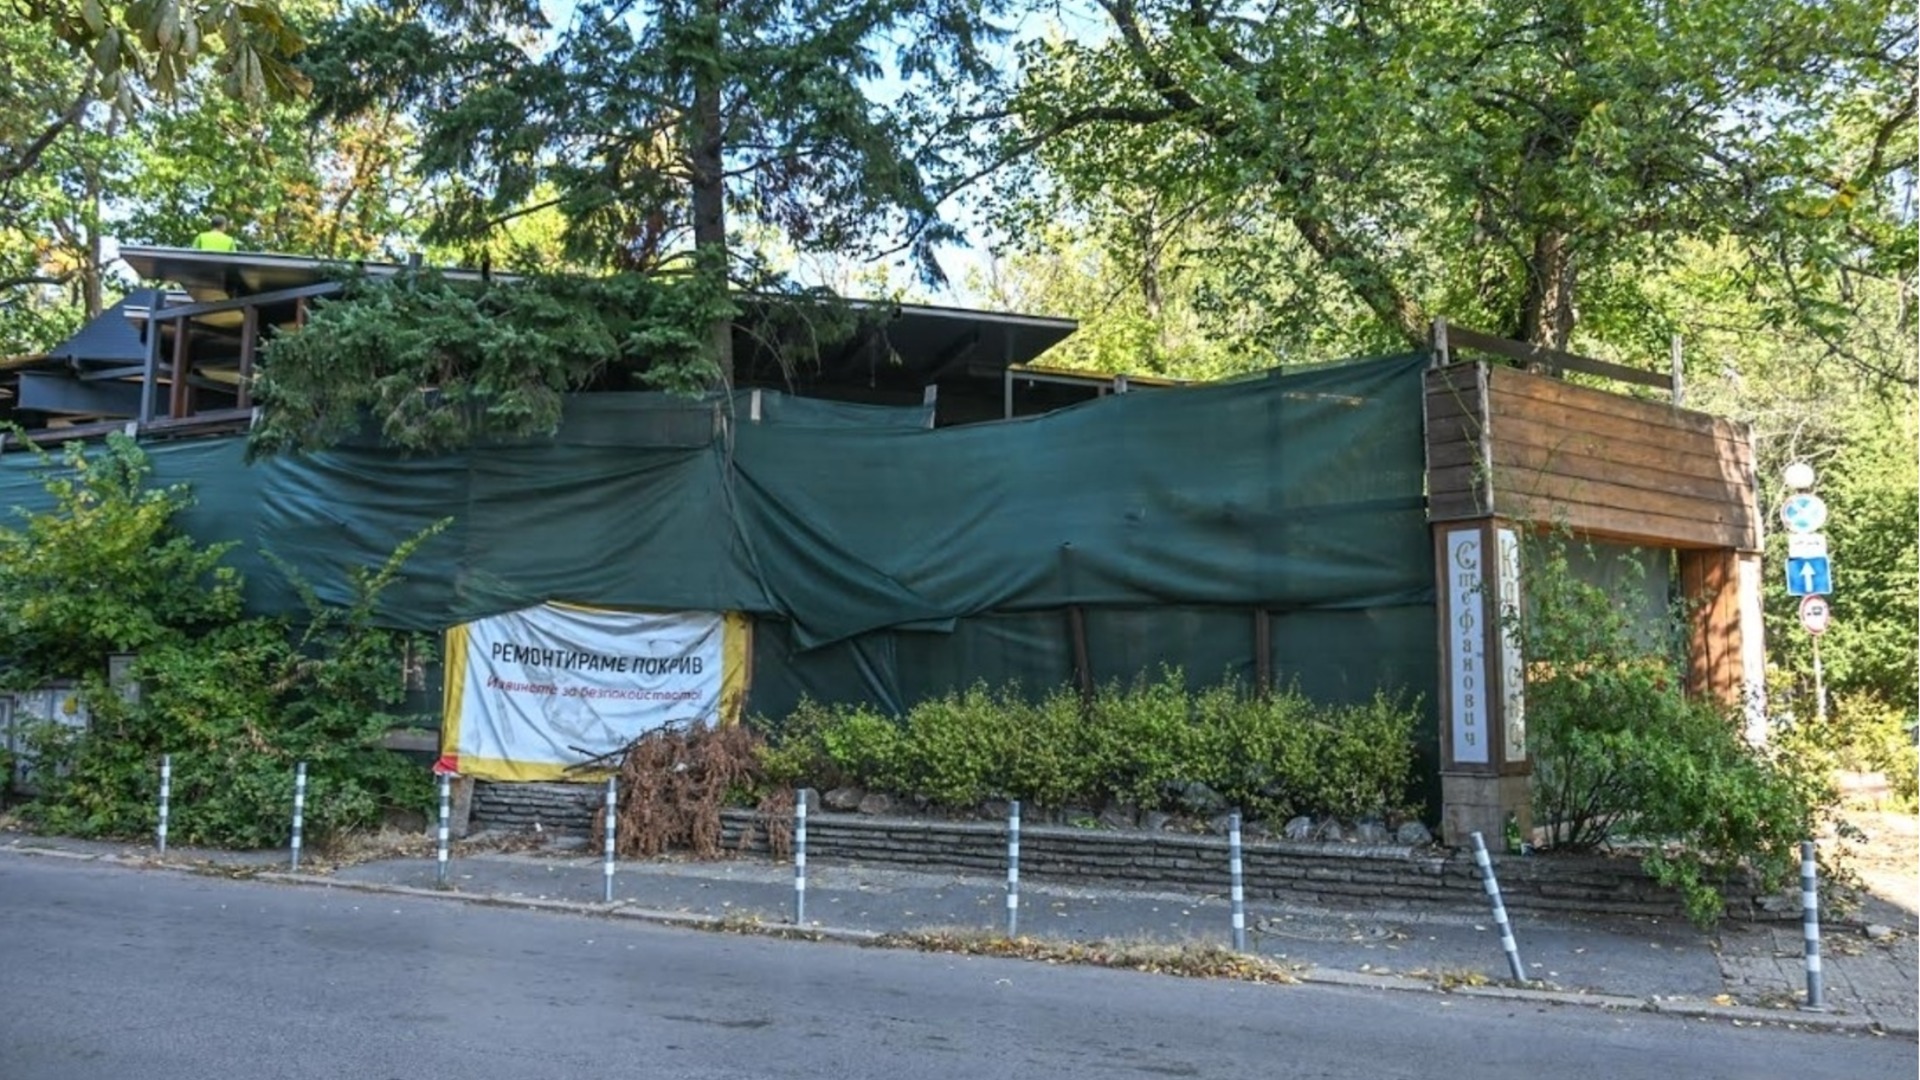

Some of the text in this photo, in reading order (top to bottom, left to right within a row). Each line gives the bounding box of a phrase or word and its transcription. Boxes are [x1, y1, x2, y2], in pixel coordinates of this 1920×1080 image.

[491, 641, 703, 675] РЕМОНТИРАМЕ ПОКРИВ
[1455, 540, 1477, 746] Стефанович
[562, 686, 578, 697] за
